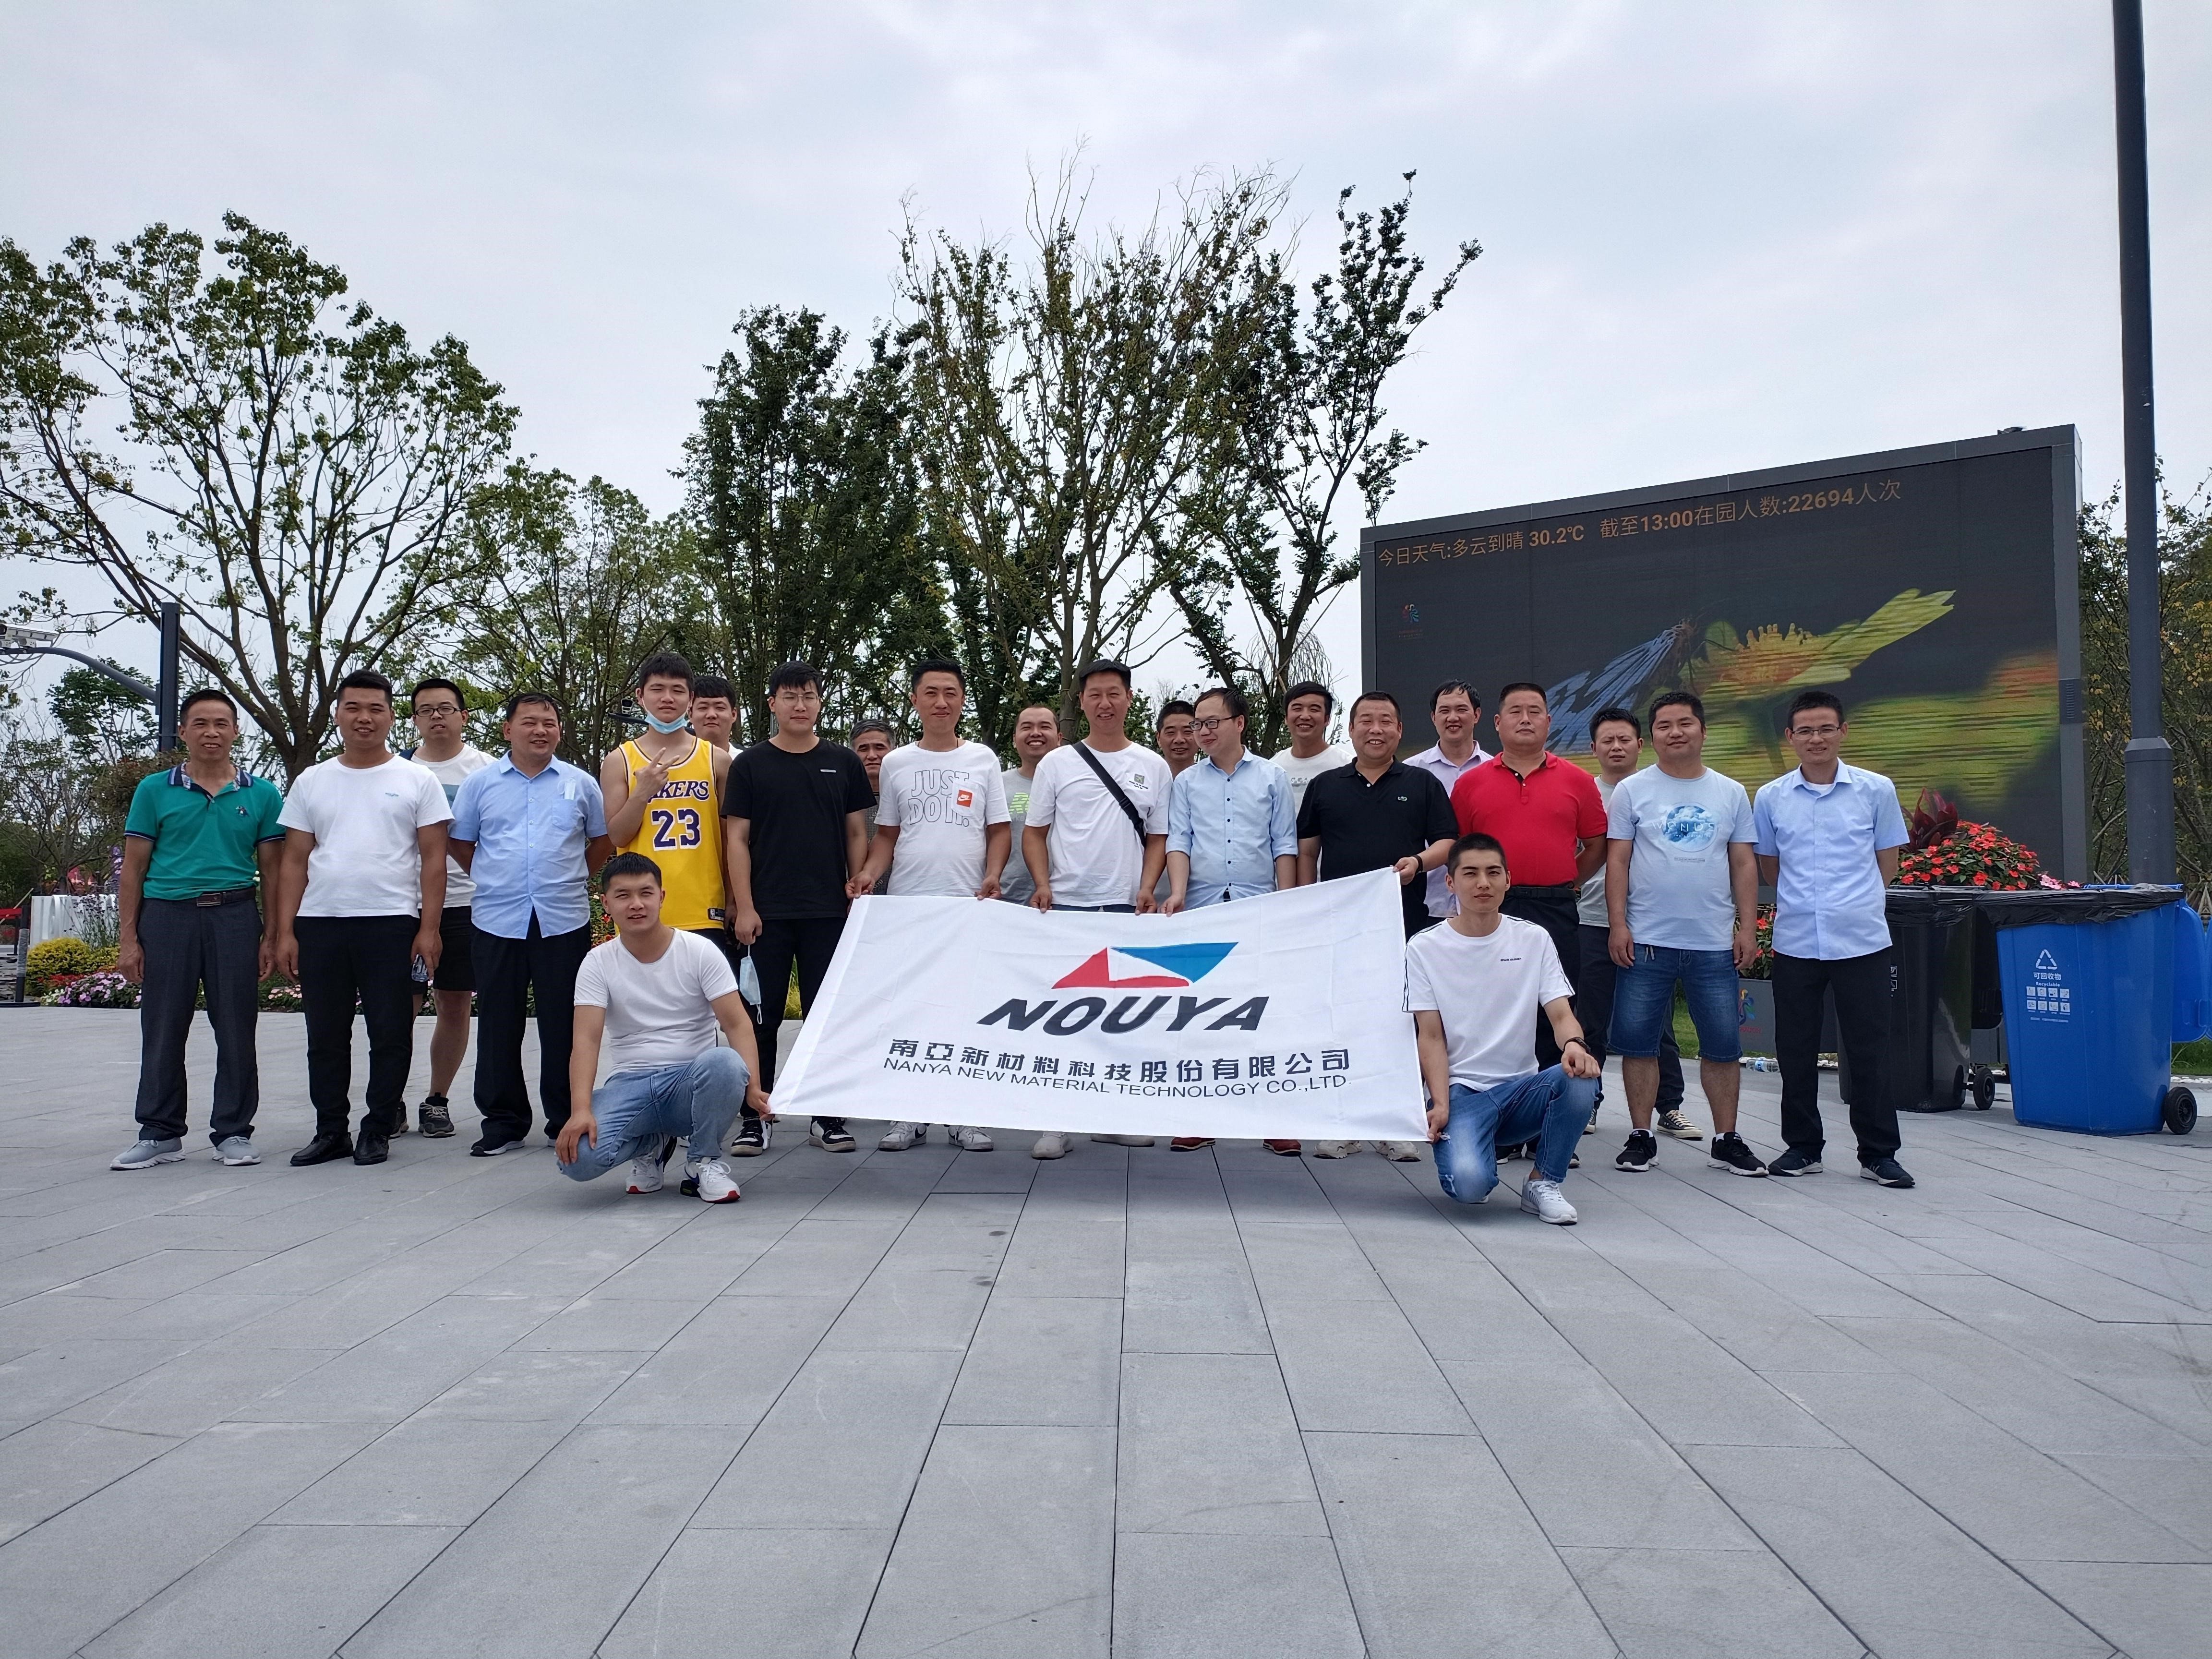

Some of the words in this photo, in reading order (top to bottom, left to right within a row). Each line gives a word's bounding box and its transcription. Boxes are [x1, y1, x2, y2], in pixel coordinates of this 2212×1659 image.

[647, 780, 709, 801] KERS
[907, 795, 942, 825] DO
[651, 808, 700, 851] 23
[2033, 972, 2061, 980] 可回收物
[976, 996, 1270, 1036] NOUYA
[884, 1058, 952, 1075] NANYA
[957, 1066, 1005, 1082] NEW
[1010, 1074, 1110, 1093] MATERIAL
[1116, 1082, 1260, 1098] TECHNOLOGY
